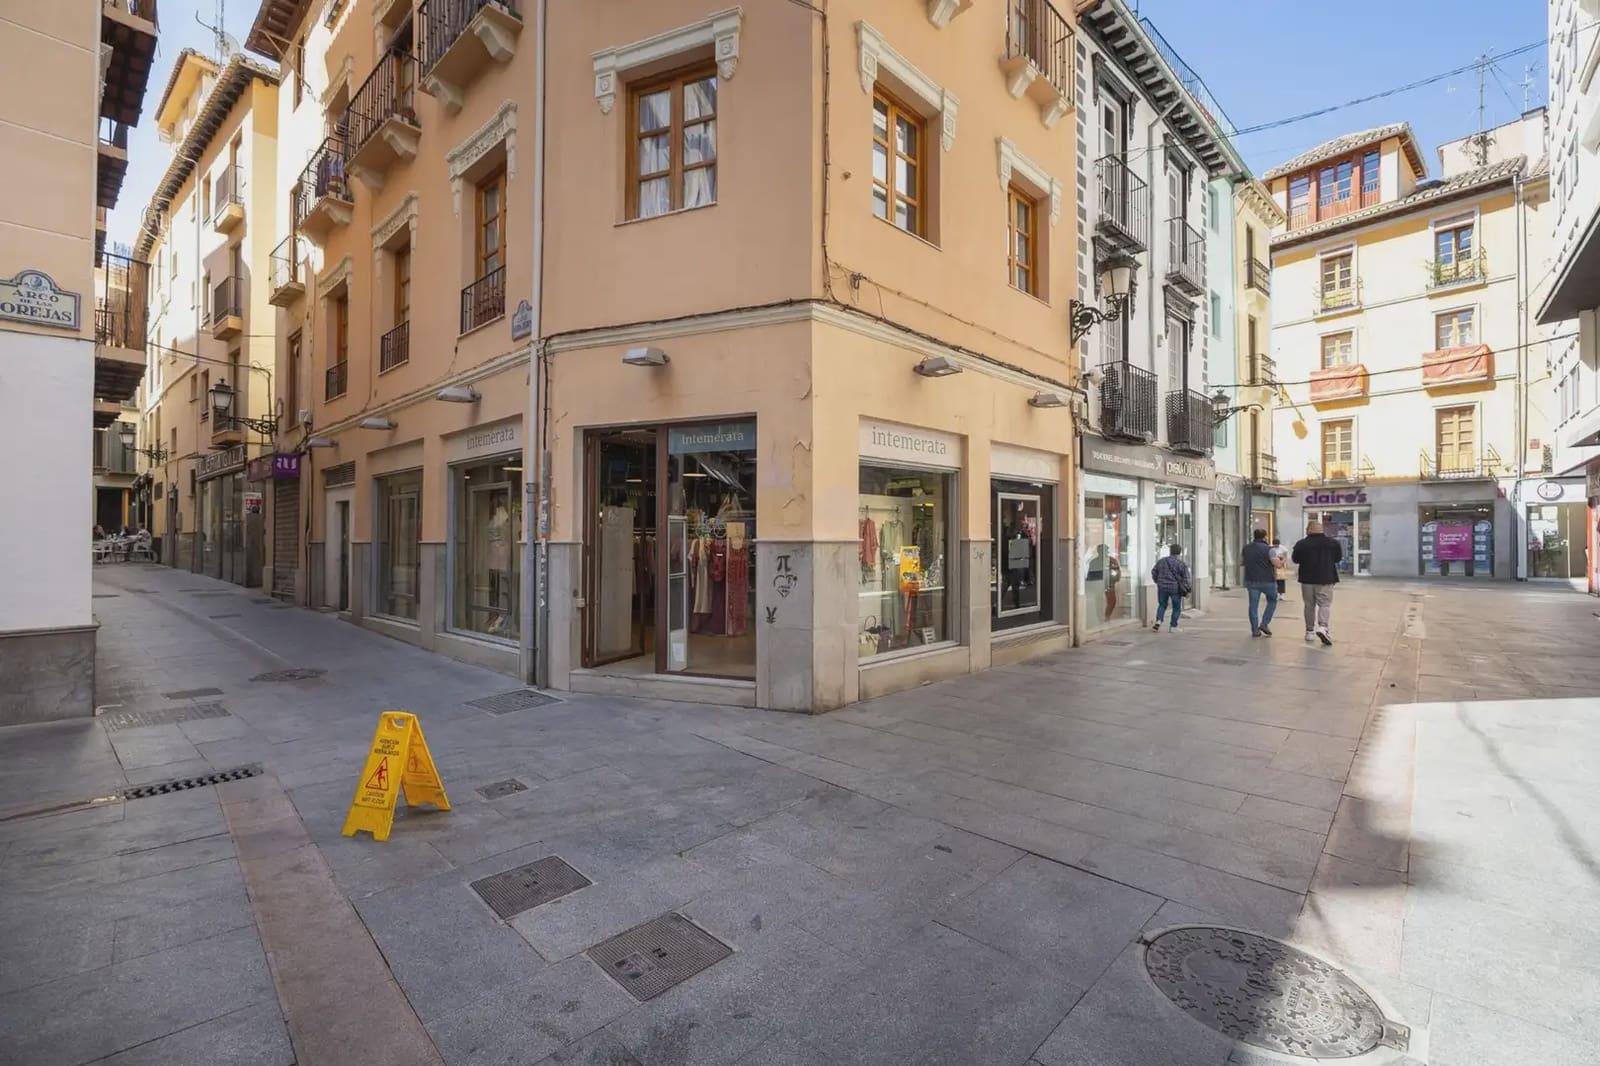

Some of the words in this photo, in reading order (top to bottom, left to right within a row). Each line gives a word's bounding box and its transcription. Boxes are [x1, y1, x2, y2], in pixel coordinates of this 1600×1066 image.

[12, 289, 59, 303] ARCO
[0, 302, 72, 321] OREJAS
[466, 429, 514, 450] intemerata
[682, 431, 744, 445] intemerata
[872, 426, 946, 455] intemerata
[1305, 490, 1367, 505] claire's
